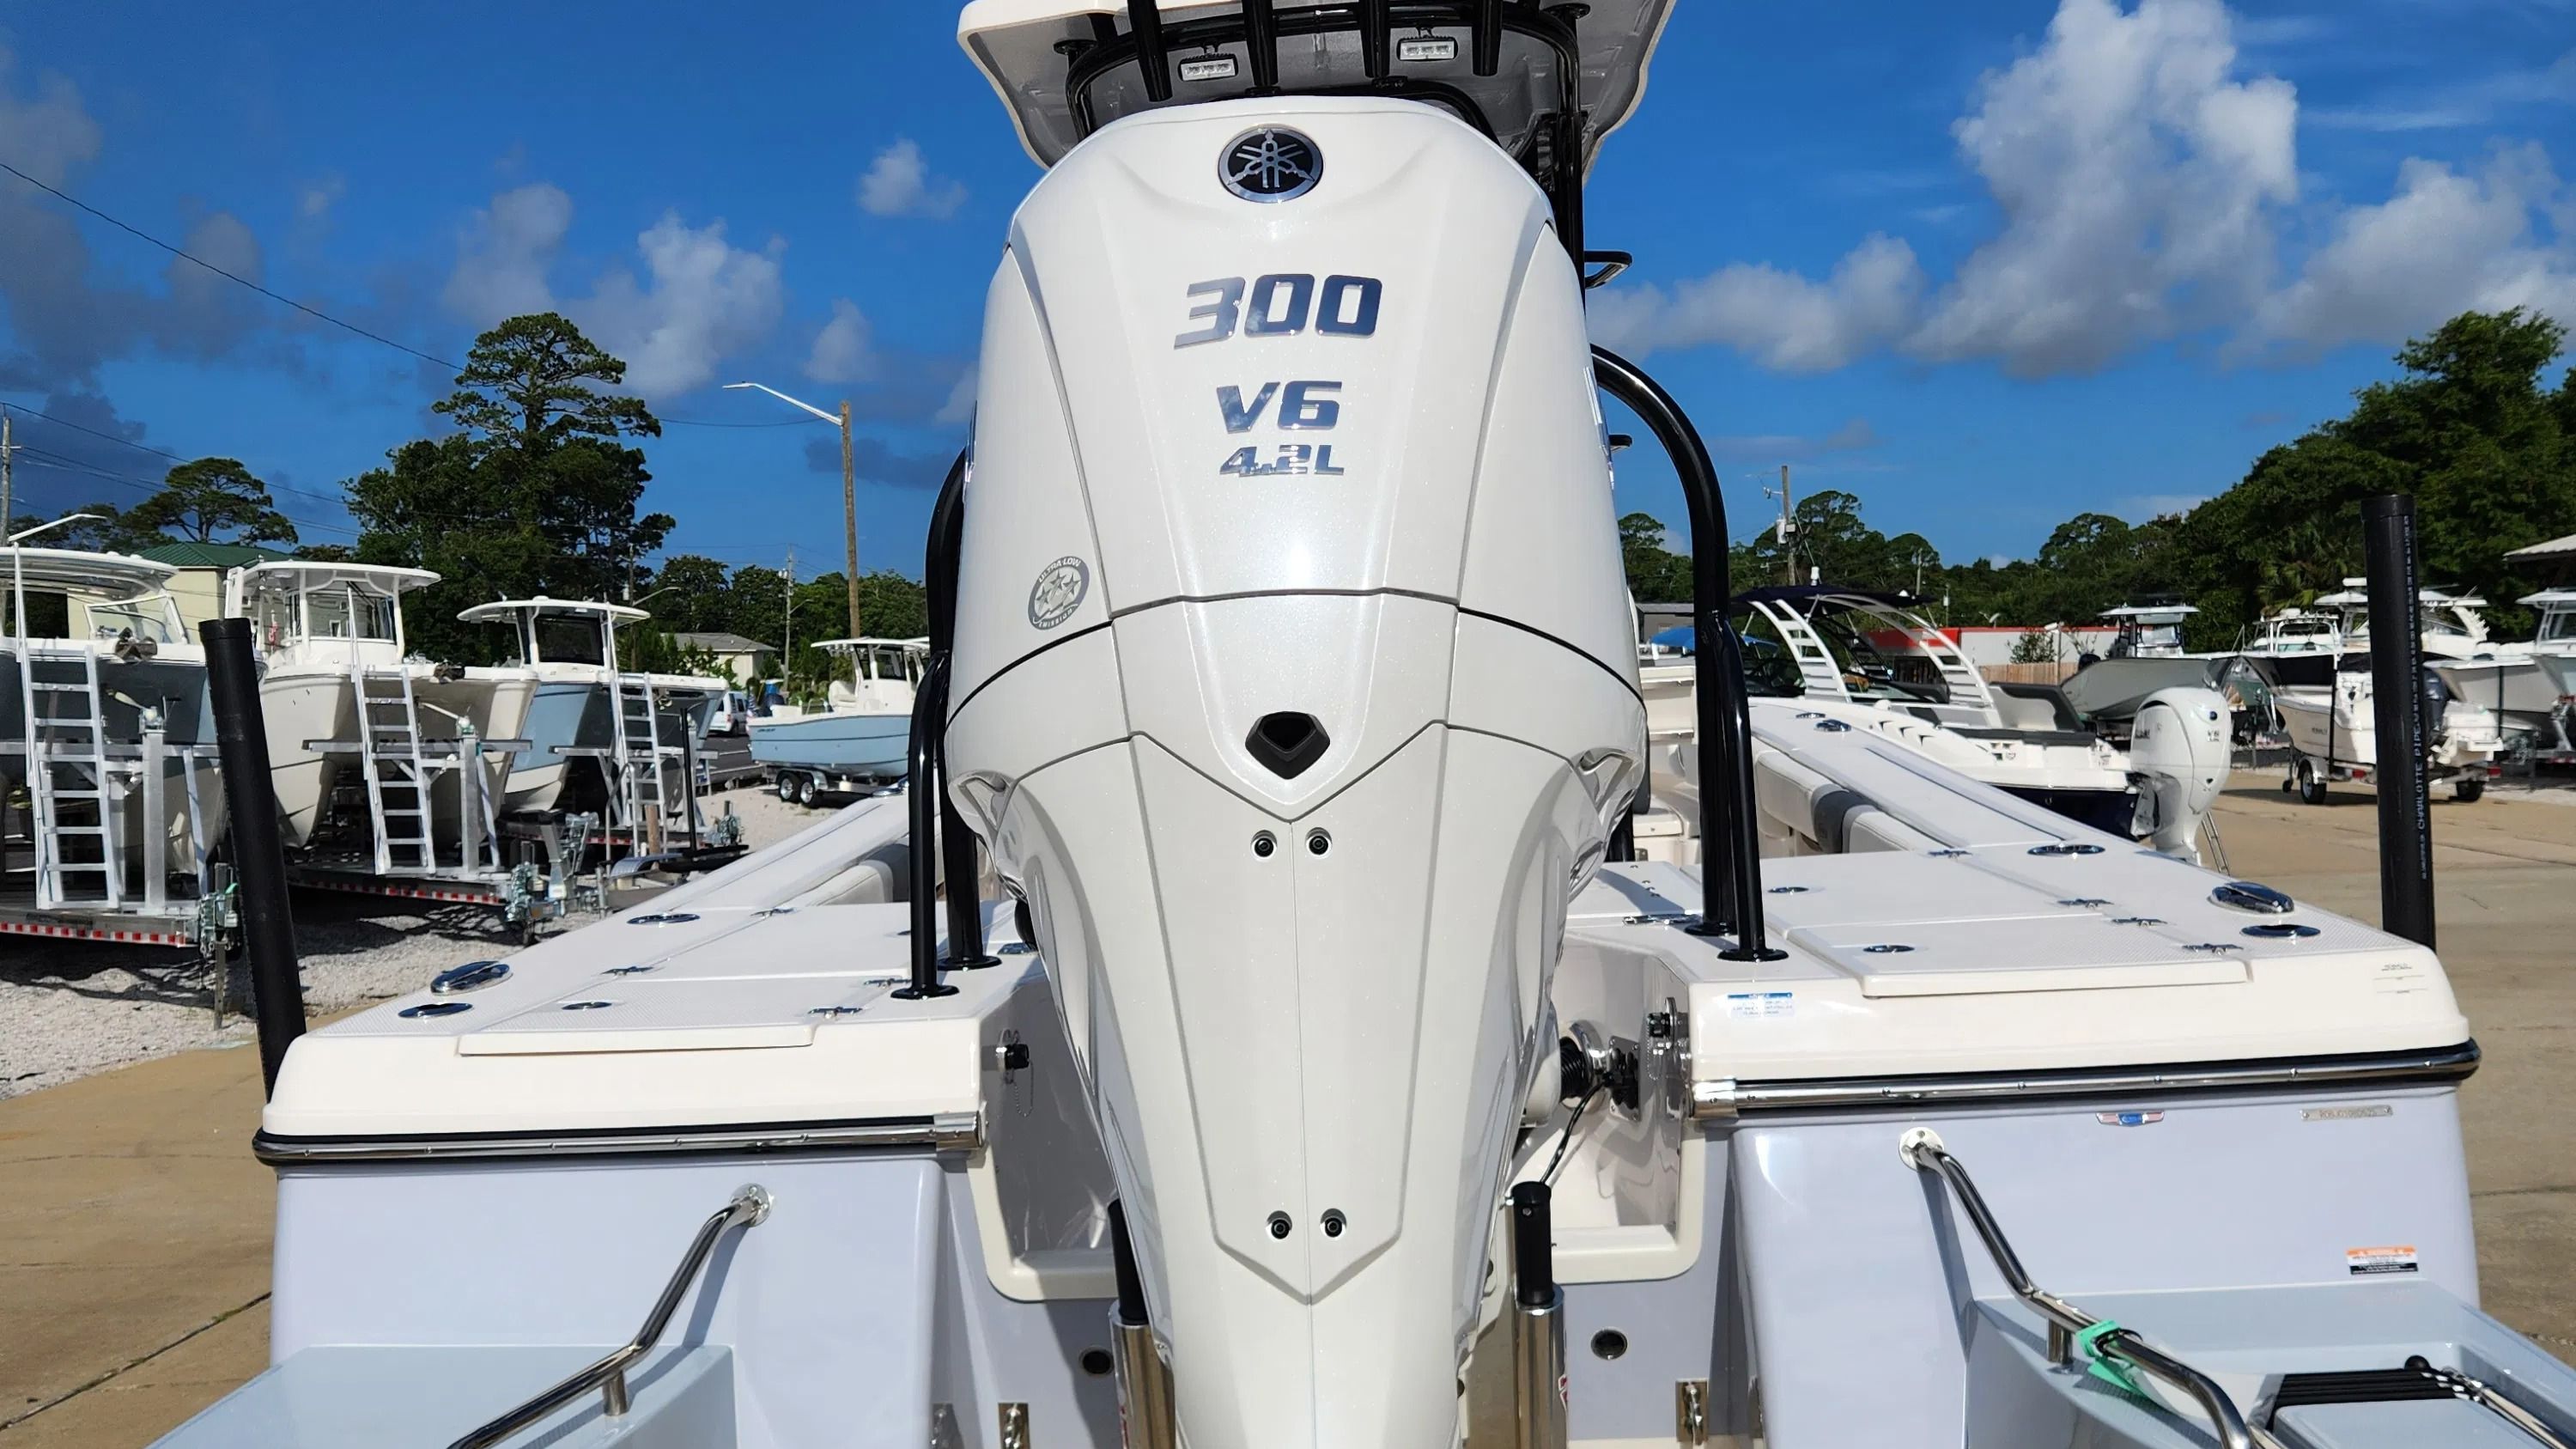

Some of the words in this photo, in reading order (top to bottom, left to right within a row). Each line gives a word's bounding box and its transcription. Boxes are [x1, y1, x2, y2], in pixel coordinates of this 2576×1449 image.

[1174, 273, 1382, 350] 300
[1216, 380, 1343, 435] V6
[1219, 444, 1345, 478] 4.2L
[1038, 560, 1062, 583] ULTRA
[1062, 557, 1082, 567] LOW
[2415, 762, 2425, 830] CHARLOTTE
